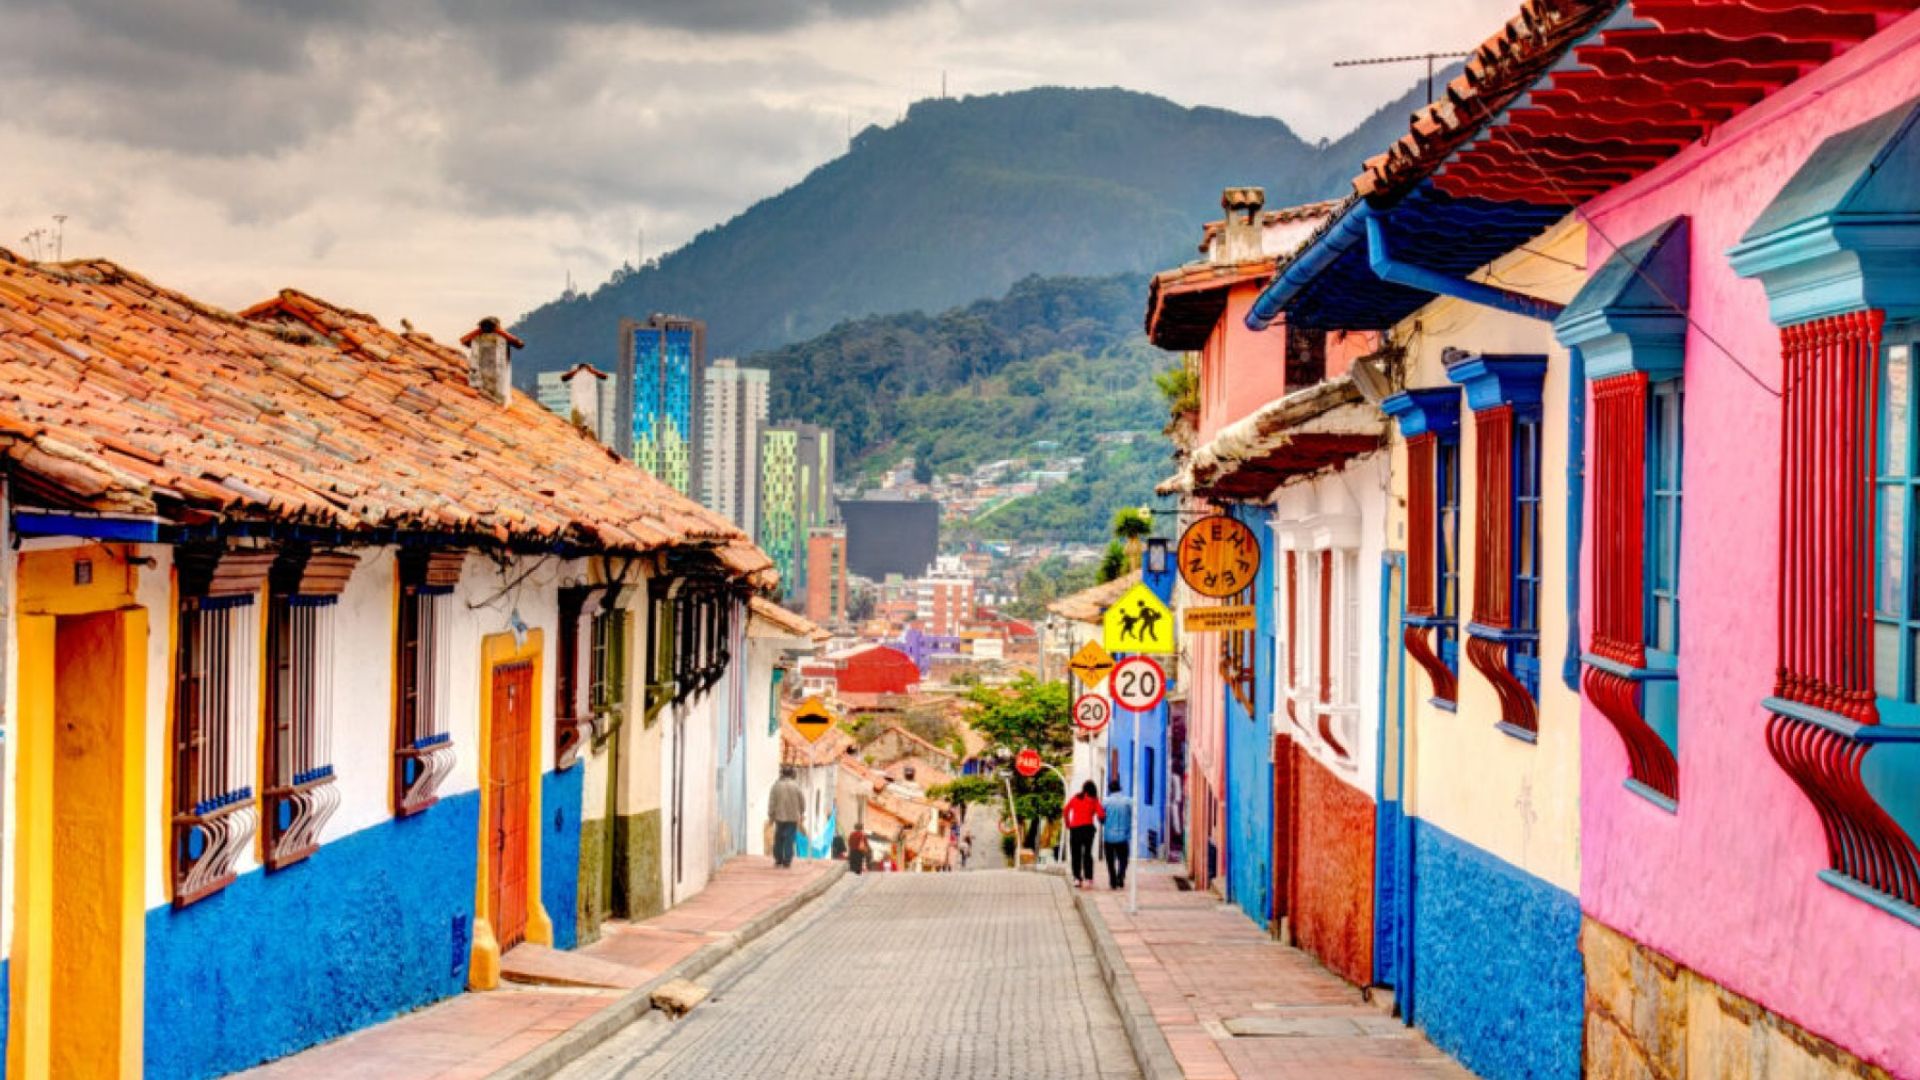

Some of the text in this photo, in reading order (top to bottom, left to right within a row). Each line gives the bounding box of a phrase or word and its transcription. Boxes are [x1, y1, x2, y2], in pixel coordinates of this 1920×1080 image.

[1121, 671, 1155, 698] 20
[1080, 703, 1103, 721] 20
[1017, 757, 1040, 768] PARE
